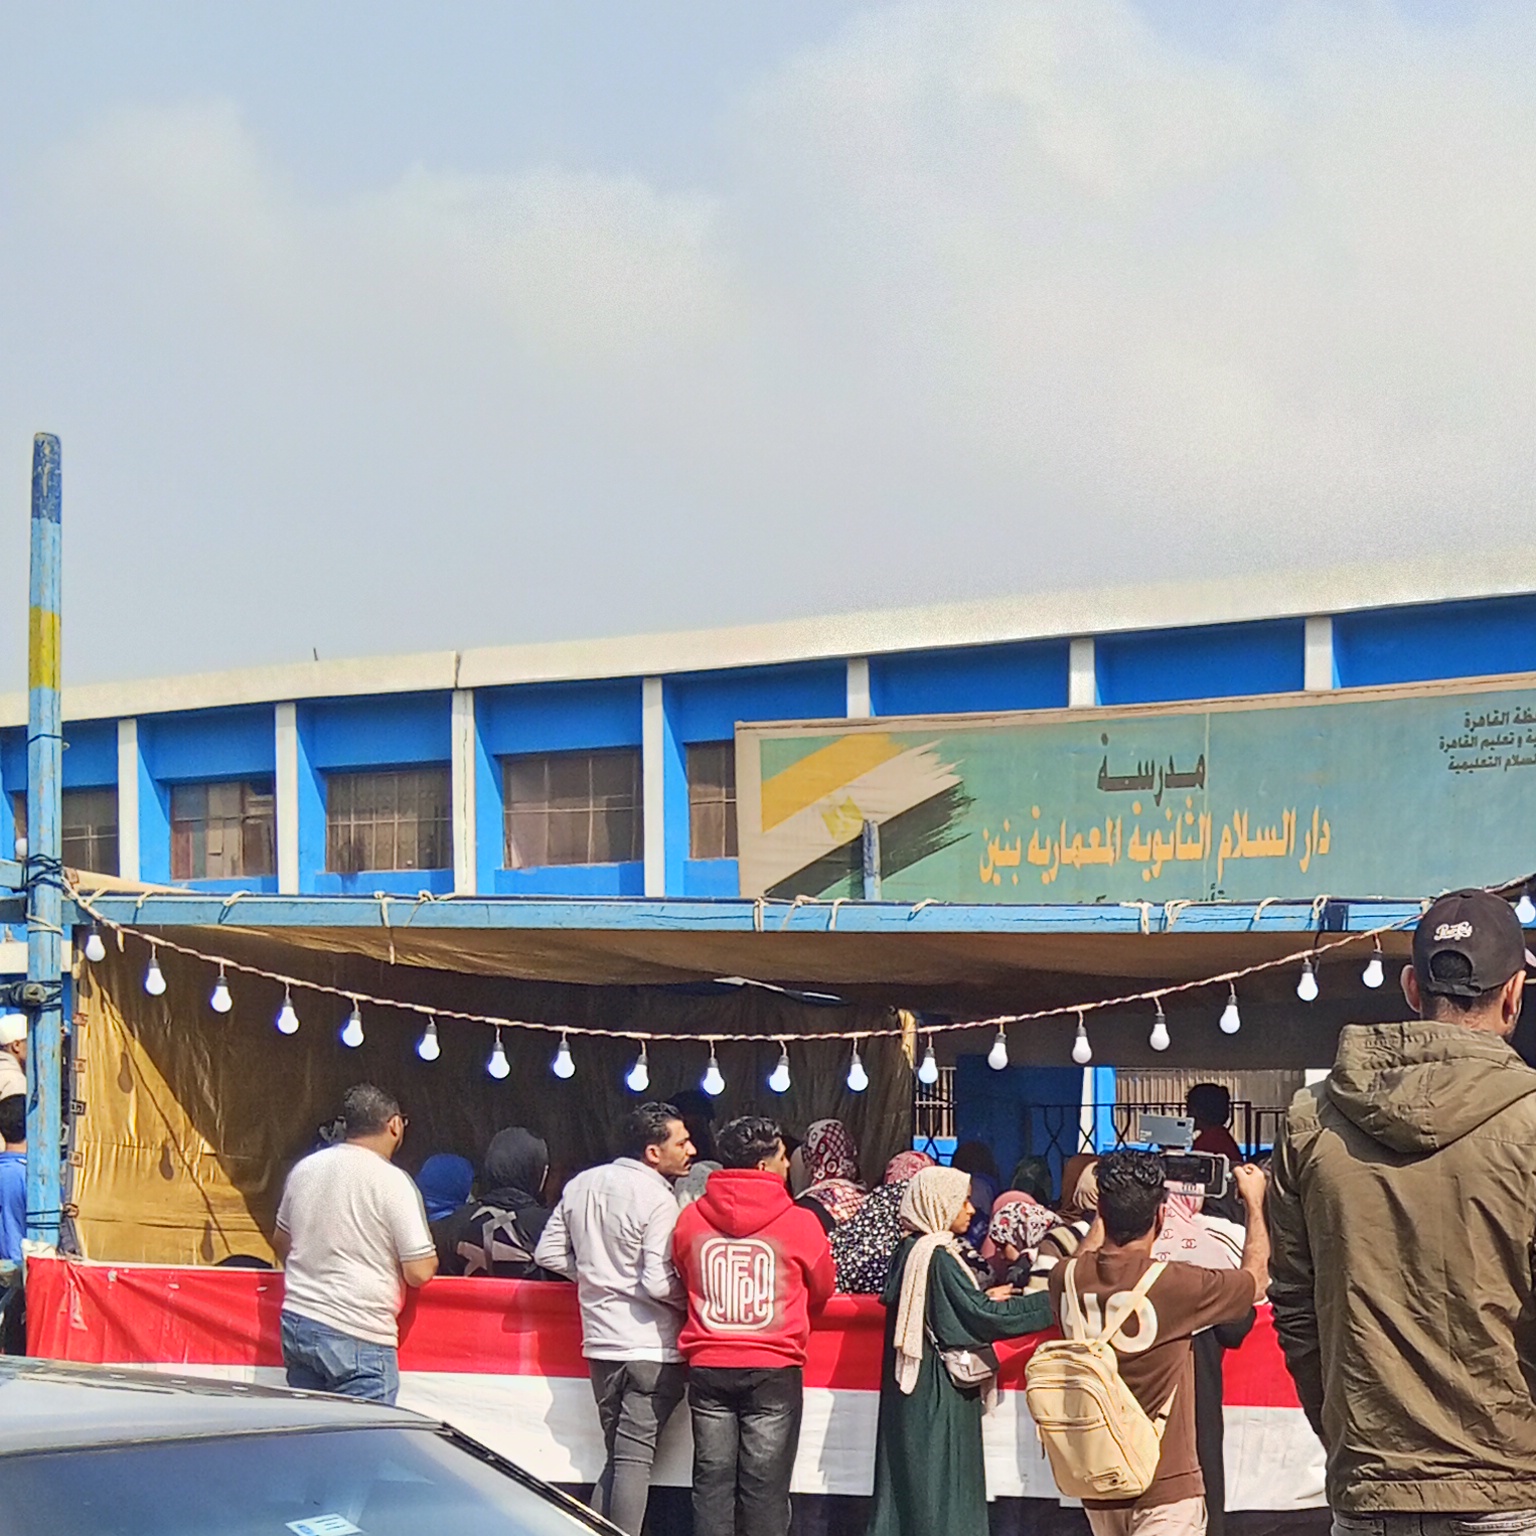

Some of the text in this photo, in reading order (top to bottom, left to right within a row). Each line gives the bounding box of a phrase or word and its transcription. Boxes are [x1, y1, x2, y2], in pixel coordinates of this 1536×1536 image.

[1463, 710, 1510, 732] القاهرة
[1439, 734, 1478, 753] القاهرة
[1480, 732, 1515, 751] تعليم
[1096, 732, 1206, 807] مدرسة
[1447, 755, 1502, 775] التعليمية
[979, 795, 1331, 887] دار السلام الثانوية المعمارية بنين
